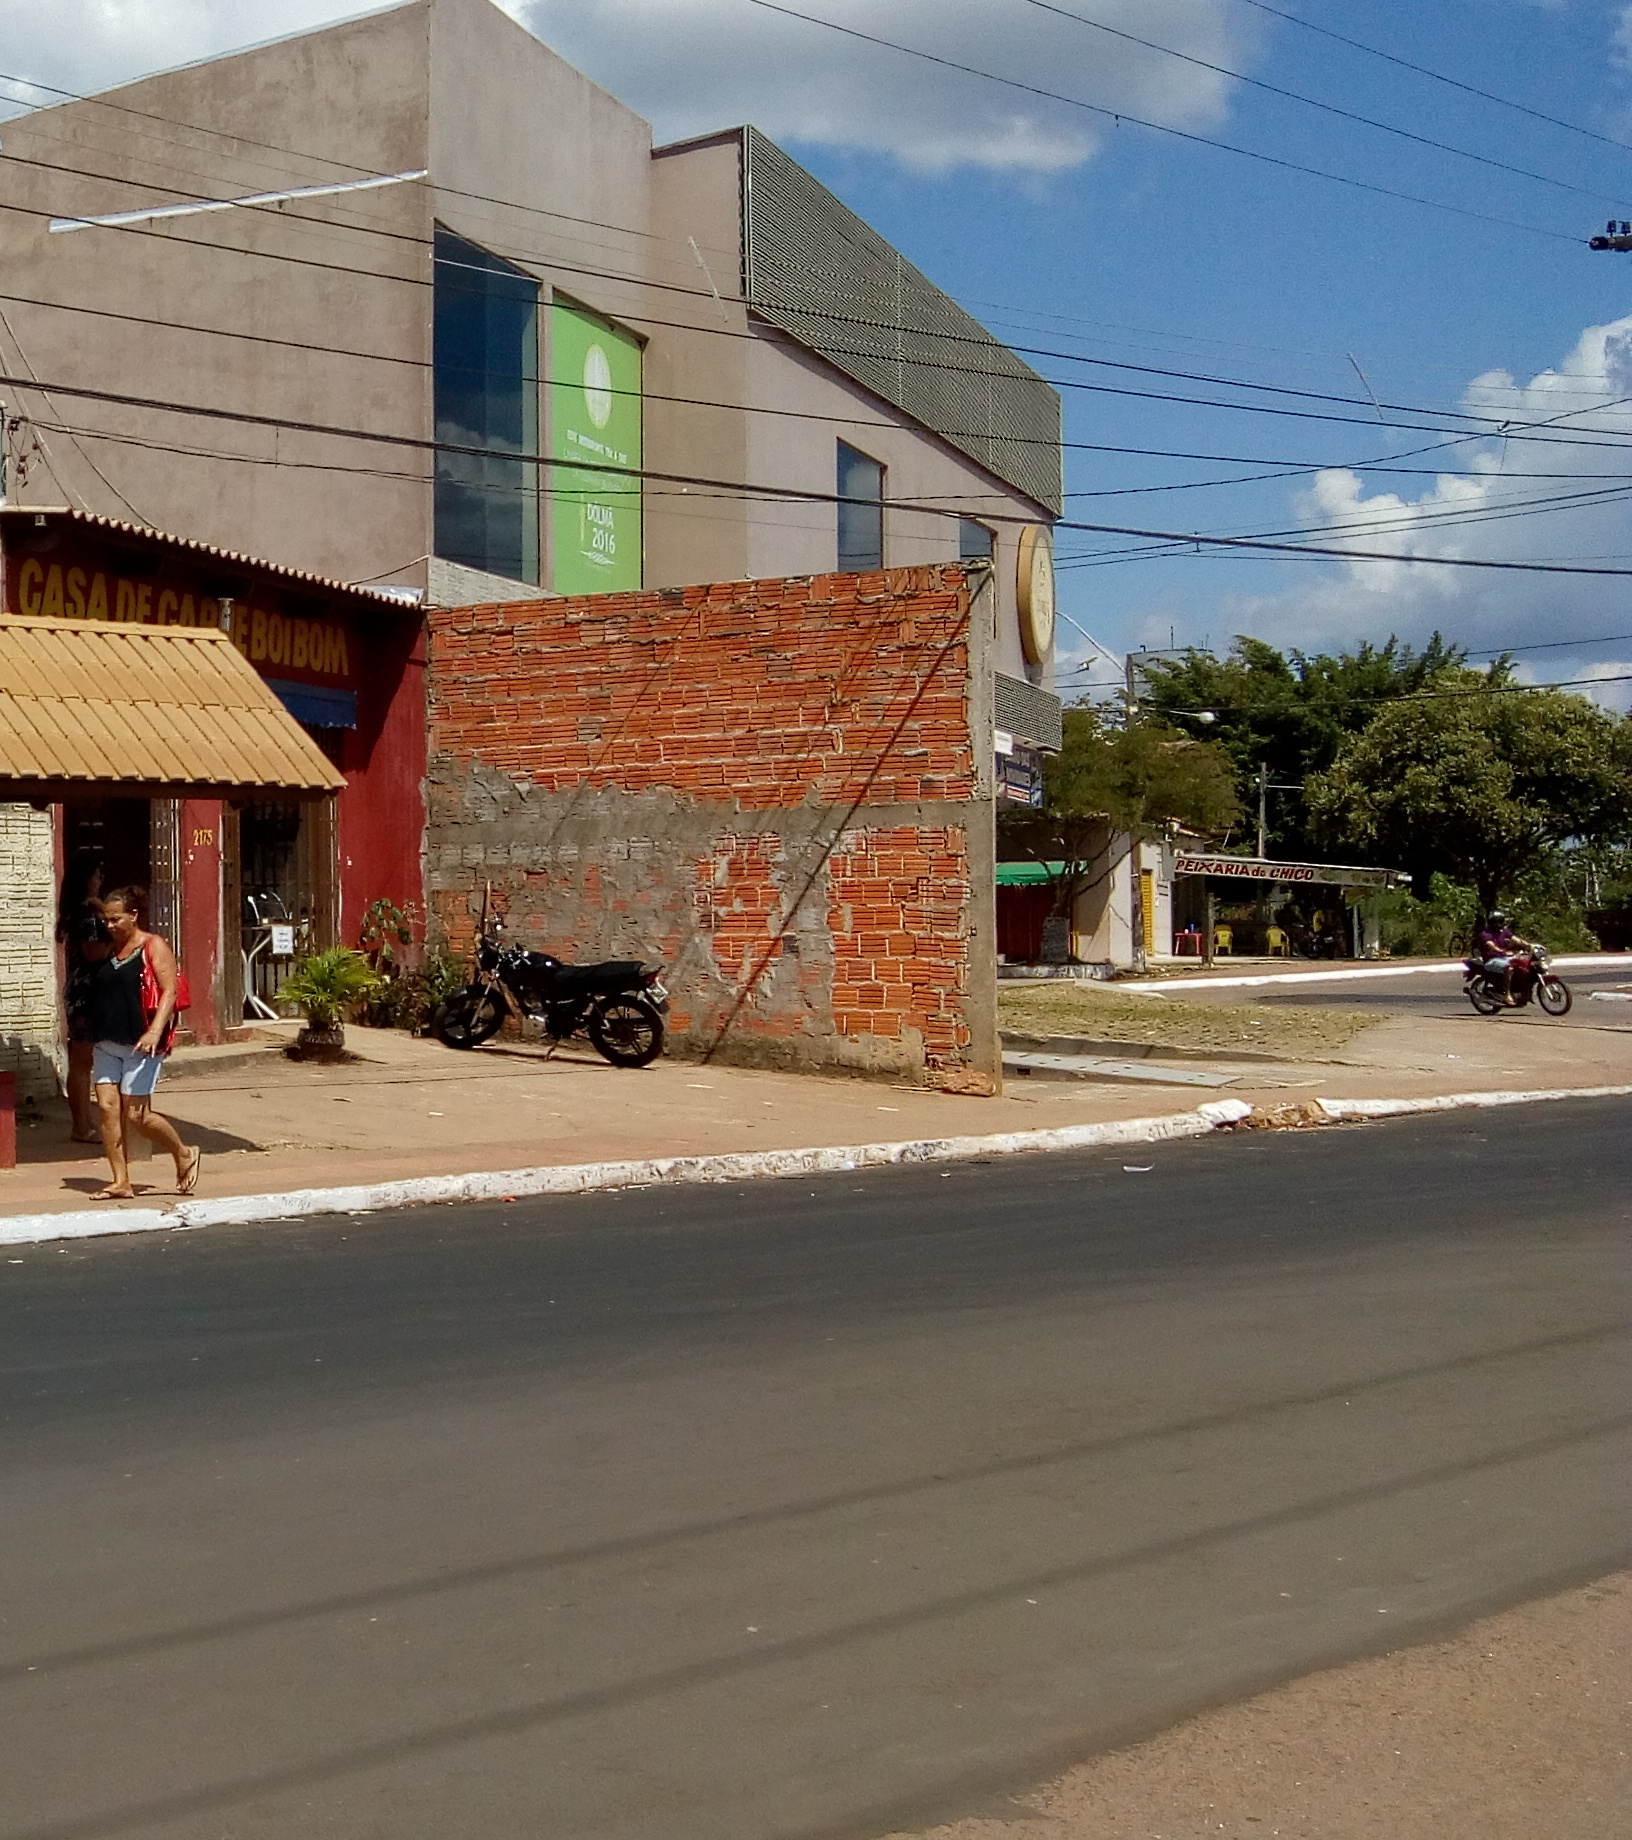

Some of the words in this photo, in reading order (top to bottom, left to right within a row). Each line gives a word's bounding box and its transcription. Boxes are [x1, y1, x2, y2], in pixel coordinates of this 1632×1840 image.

[592, 527, 616, 554] 2016
[19, 557, 108, 622] CASA
[116, 578, 152, 623] DE
[157, 589, 248, 656] CARE
[193, 829, 213, 847] 2175
[1175, 859, 1250, 876] PEIXARIA
[1269, 868, 1315, 881] CHICO
